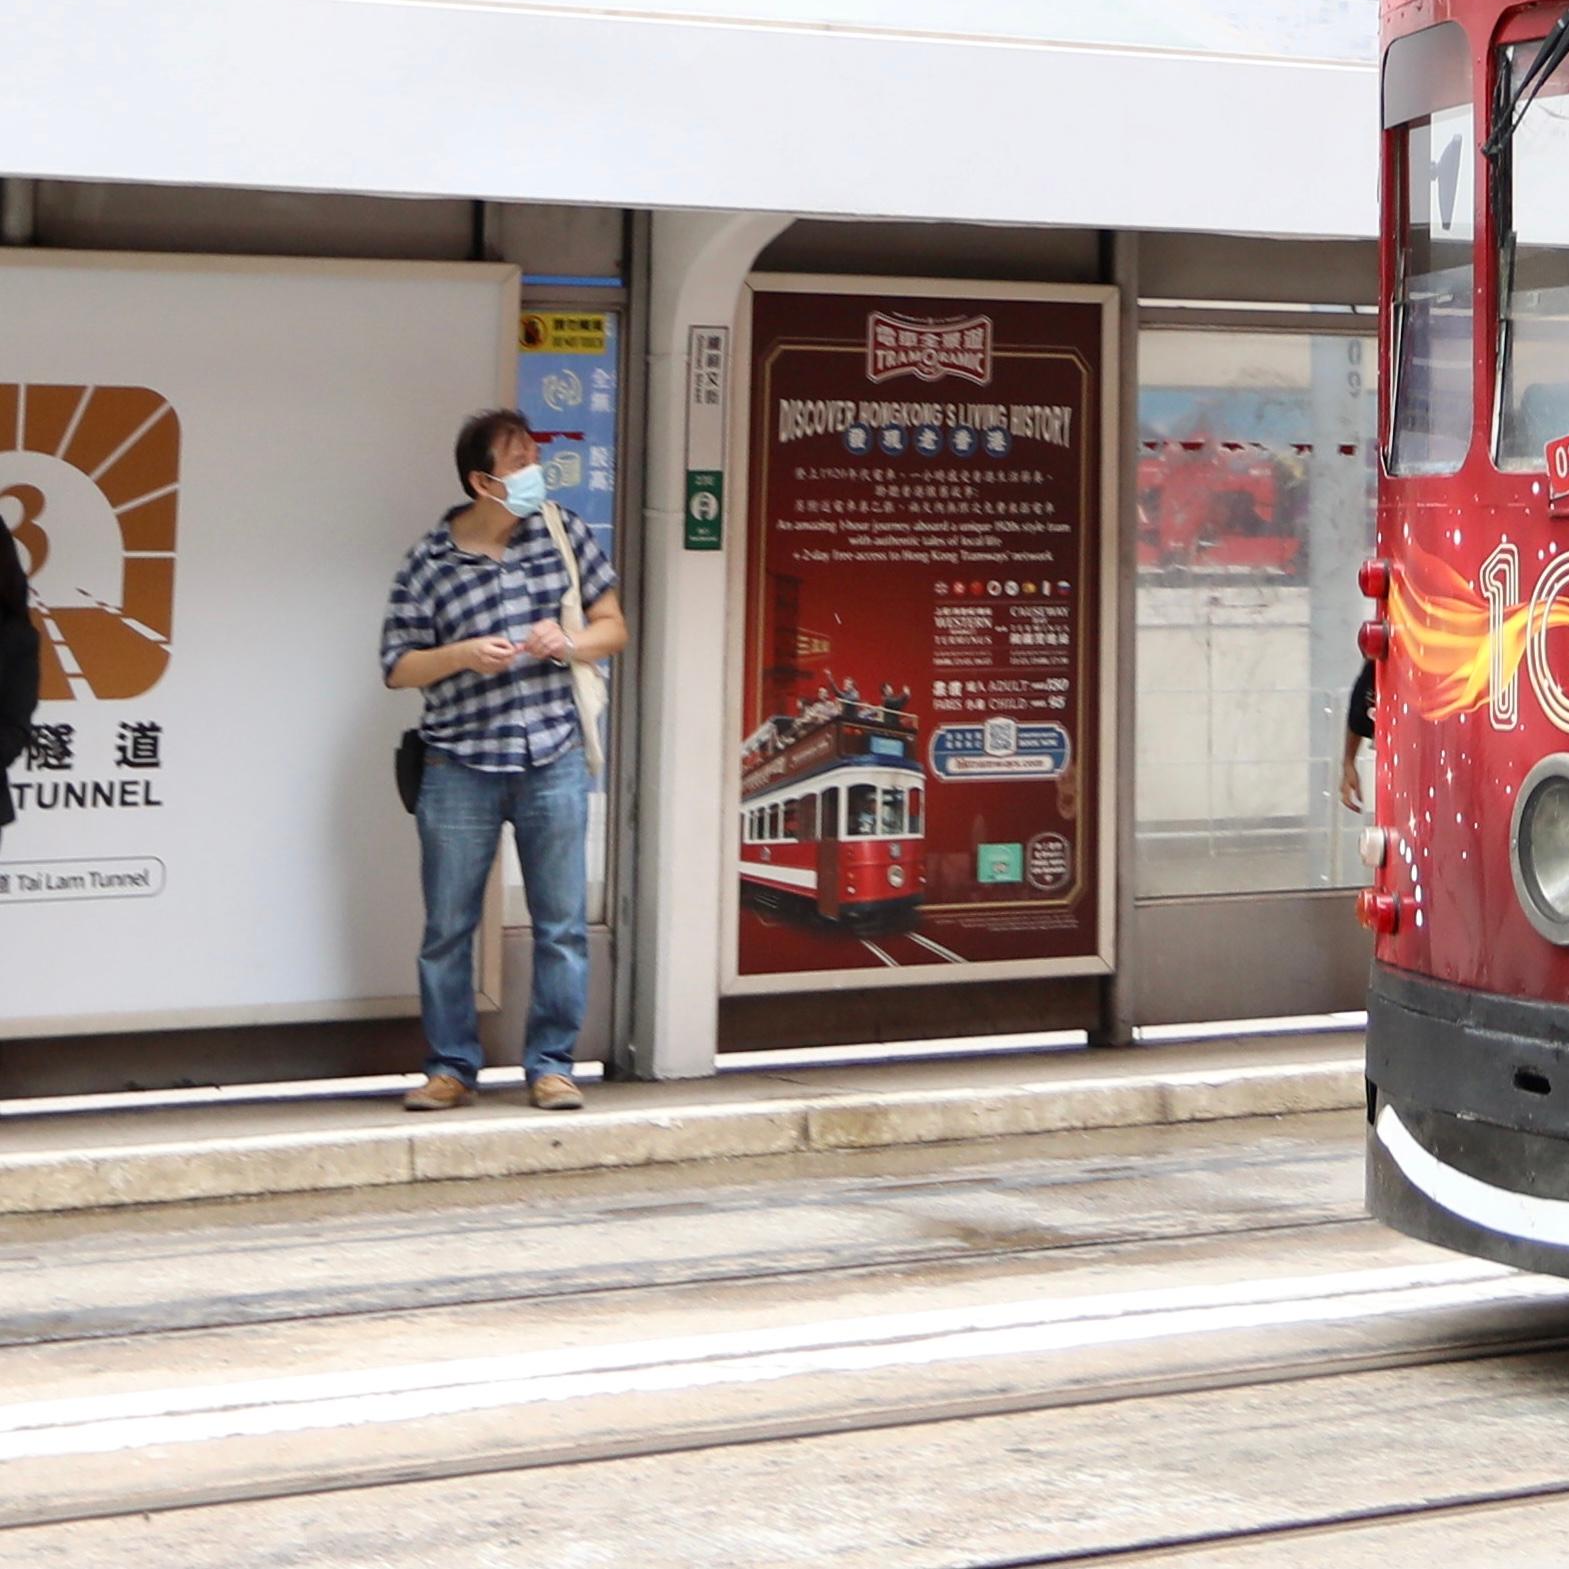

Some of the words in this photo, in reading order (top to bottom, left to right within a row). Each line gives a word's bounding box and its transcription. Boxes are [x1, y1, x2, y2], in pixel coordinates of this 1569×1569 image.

[779, 398, 857, 443] DISCOVER
[959, 403, 1008, 429] LIVING
[1009, 404, 1073, 448] HISTORY
[10, 779, 164, 810] TUNNEL
[17, 872, 43, 892] Tai
[46, 873, 86, 891] Lam
[88, 868, 151, 890] Tunnel
